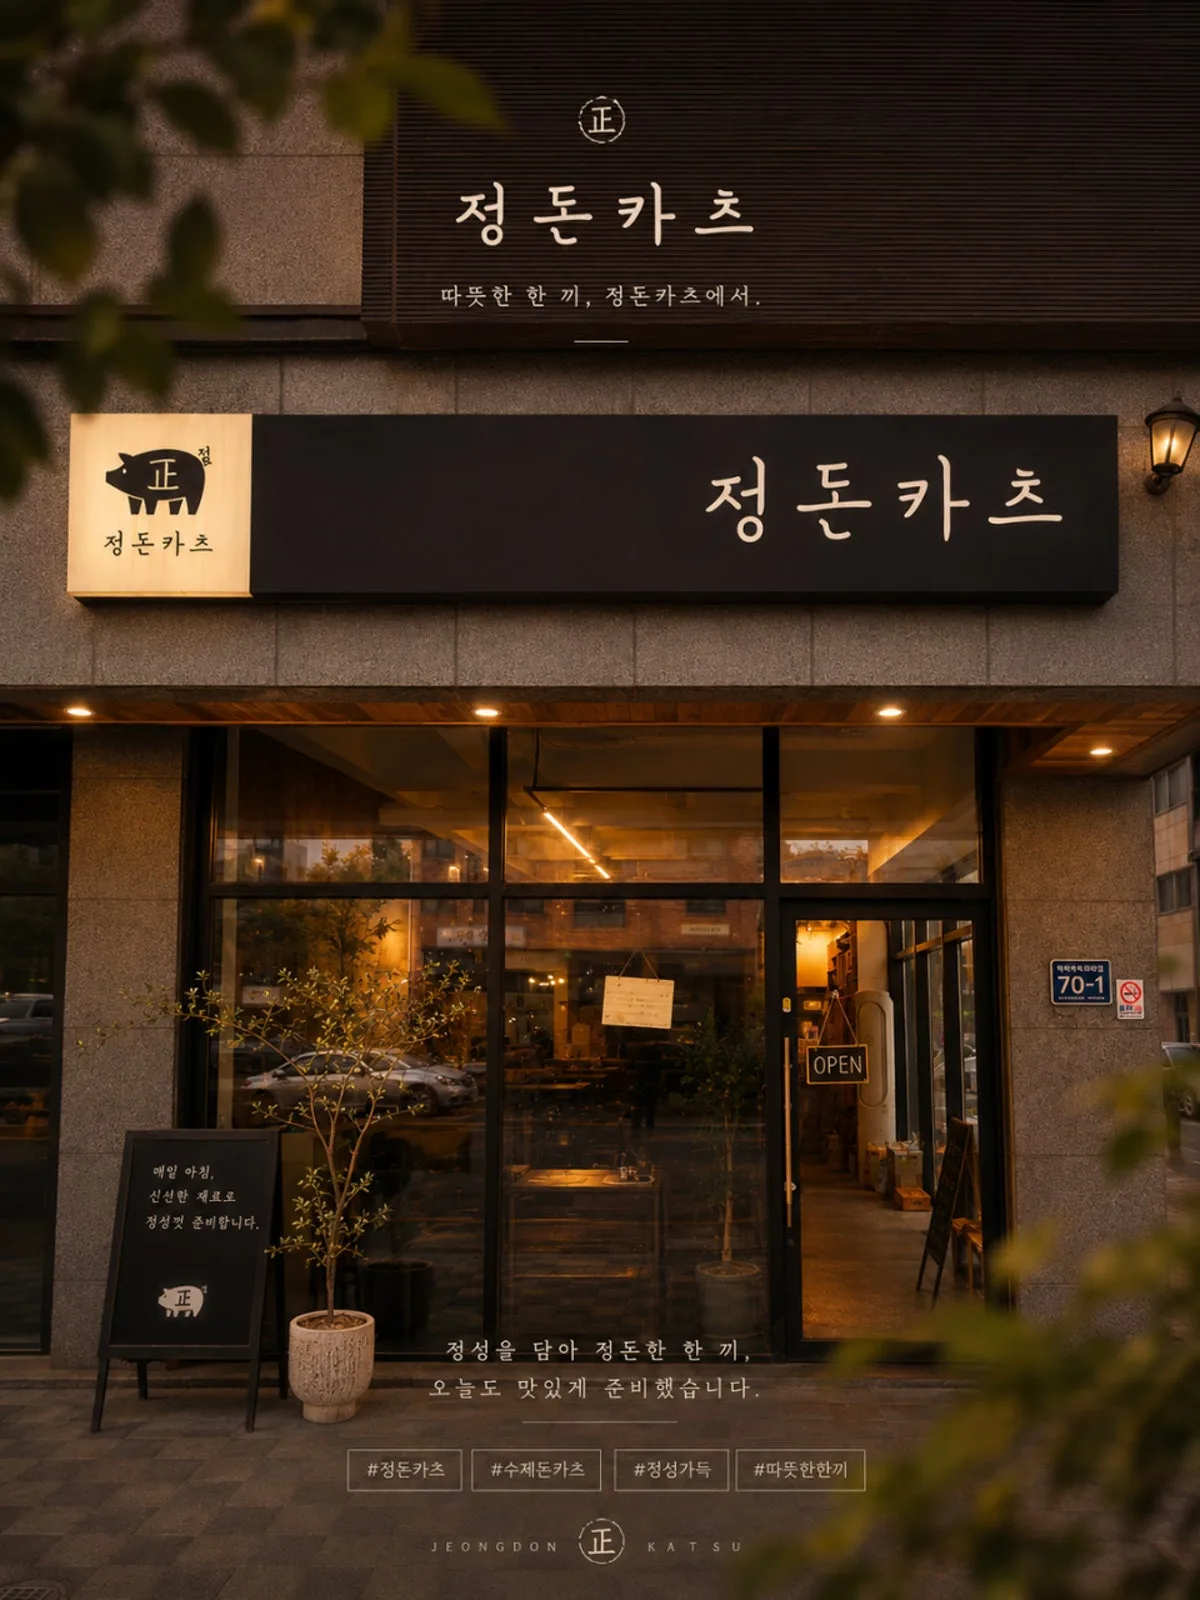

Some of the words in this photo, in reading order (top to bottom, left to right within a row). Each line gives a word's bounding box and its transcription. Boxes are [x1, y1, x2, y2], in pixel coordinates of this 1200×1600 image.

[147, 458, 179, 491] 正
[705, 454, 1063, 543] 정돈카츠
[104, 529, 213, 557] 정돈카츠
[1057, 975, 1104, 995] 70-1
[813, 1055, 862, 1075] OPEN
[153, 1165, 178, 1180] 매일
[184, 1165, 214, 1180] 아침,
[146, 1215, 185, 1230] 정성껏
[192, 1215, 260, 1230] 준비합니다.
[175, 1289, 191, 1307] 正
